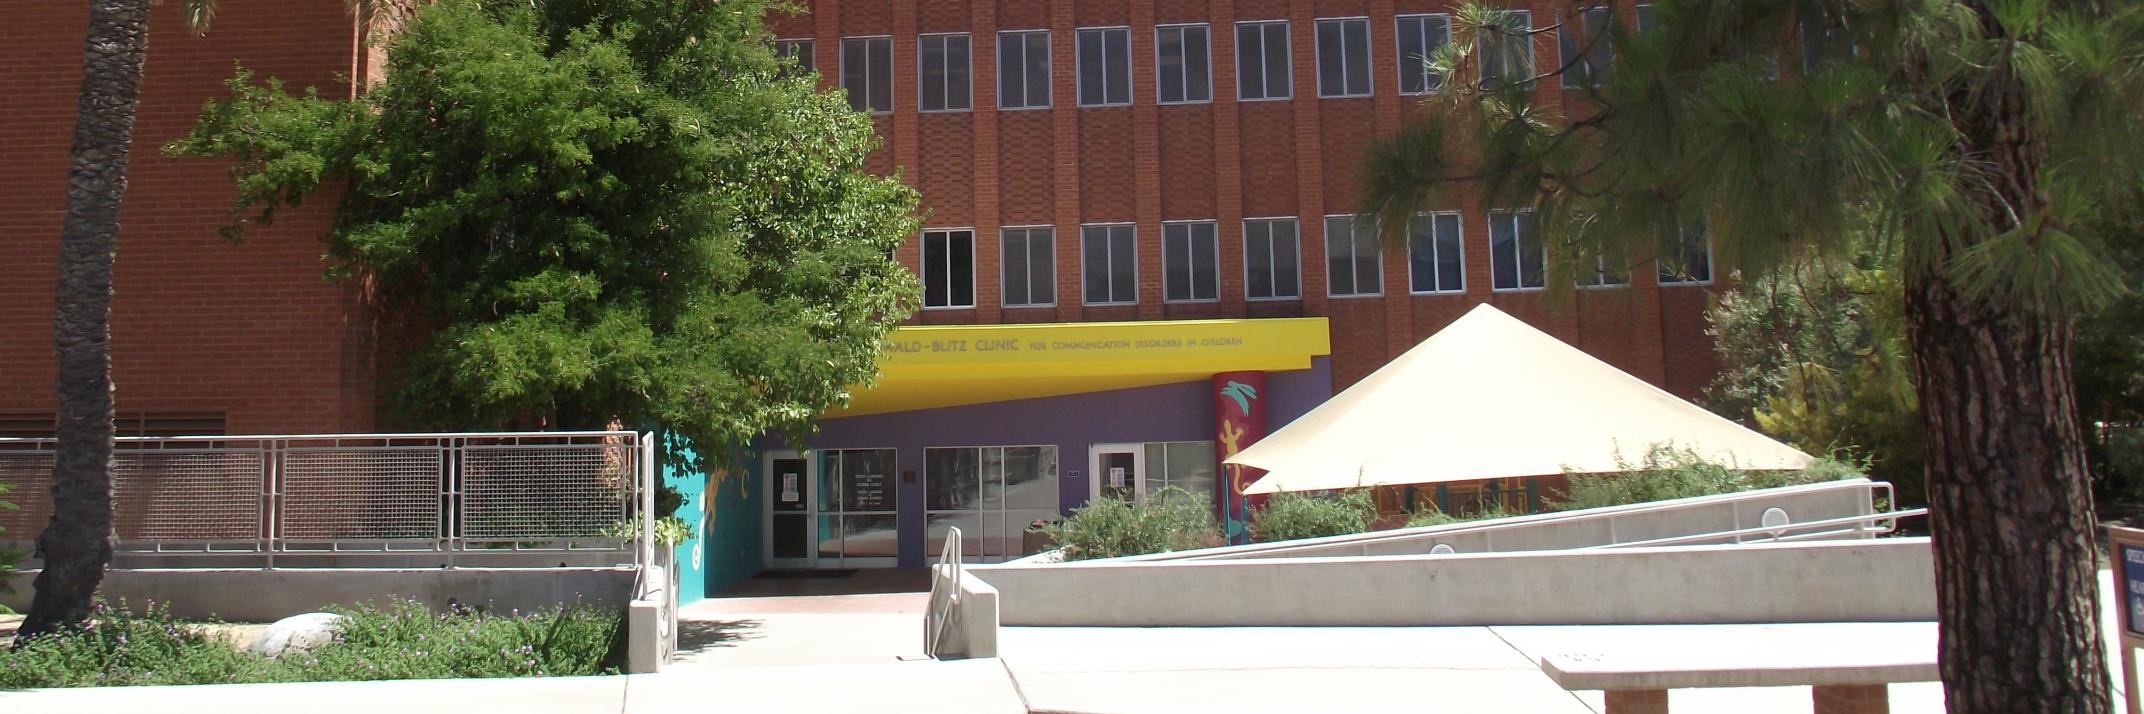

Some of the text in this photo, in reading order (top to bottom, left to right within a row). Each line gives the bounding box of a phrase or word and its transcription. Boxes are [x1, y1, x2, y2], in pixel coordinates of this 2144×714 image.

[882, 336, 1243, 353] WALD-BLITZ CLINIC FOR COMMUNICATION DISORDERS IN CHILDREN
